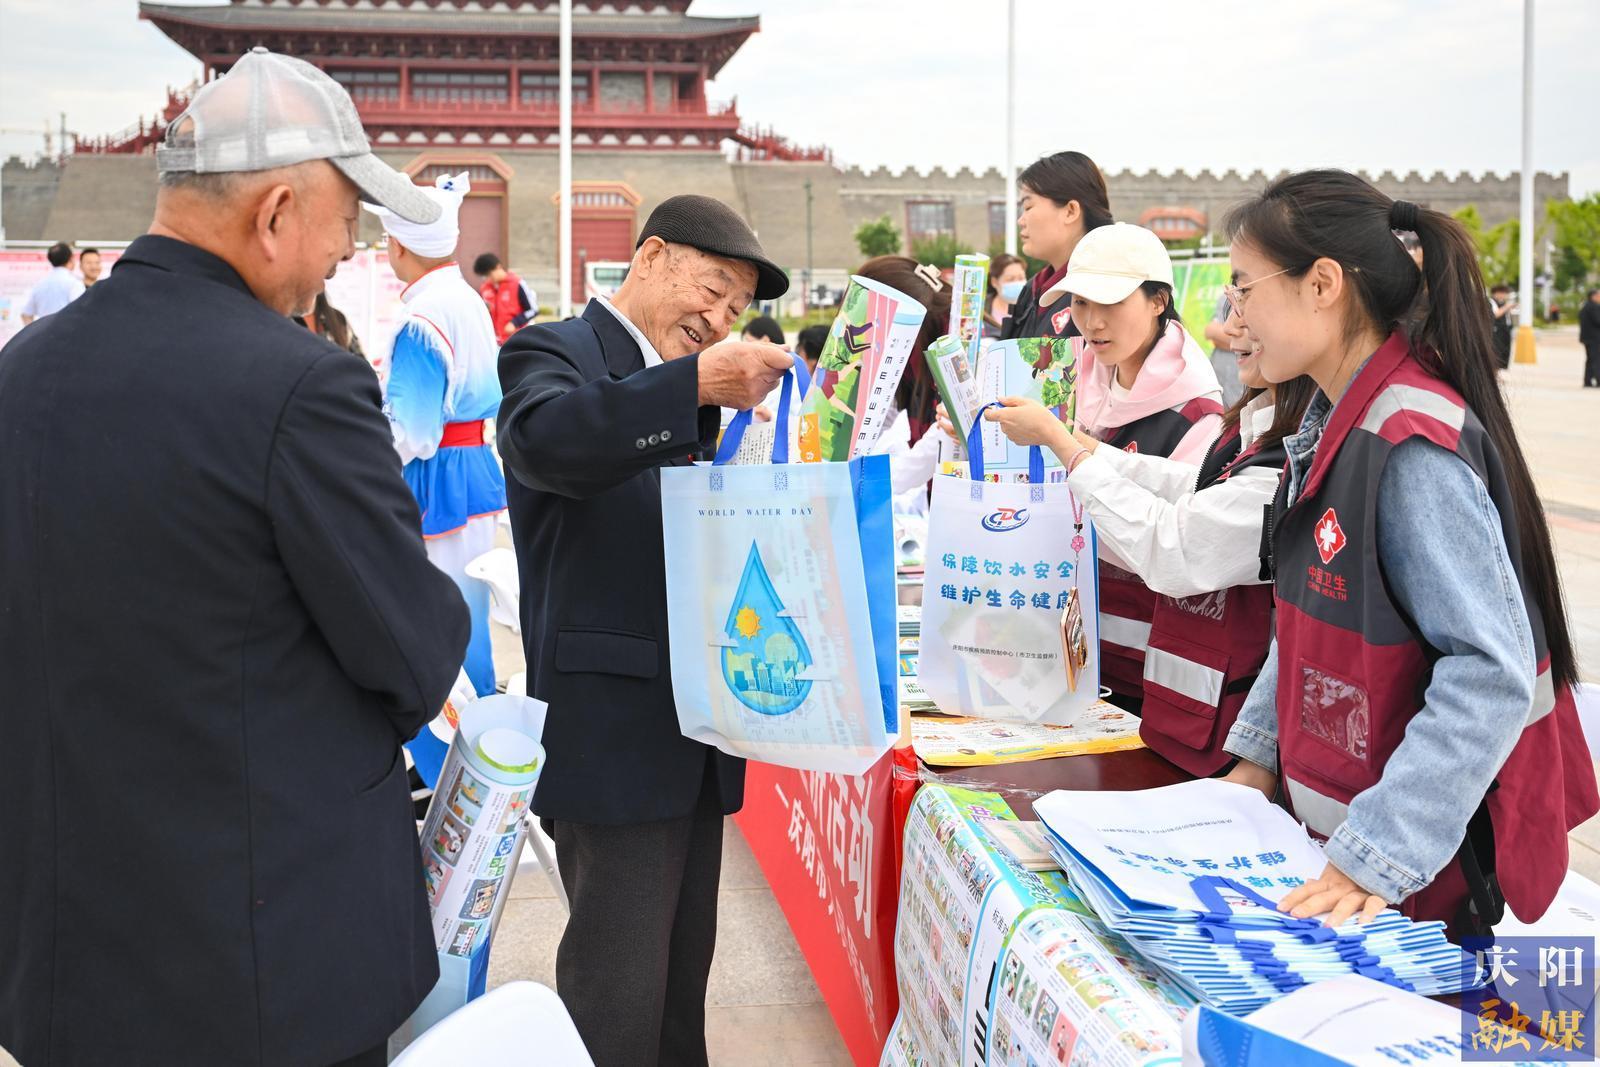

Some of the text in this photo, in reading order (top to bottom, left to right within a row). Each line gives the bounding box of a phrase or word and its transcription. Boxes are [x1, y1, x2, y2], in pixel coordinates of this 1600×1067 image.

[698, 506, 814, 517] WORLD WATER DAY
[941, 552, 1075, 579] 保障饮水安全
[1307, 564, 1348, 592] 中国卫生
